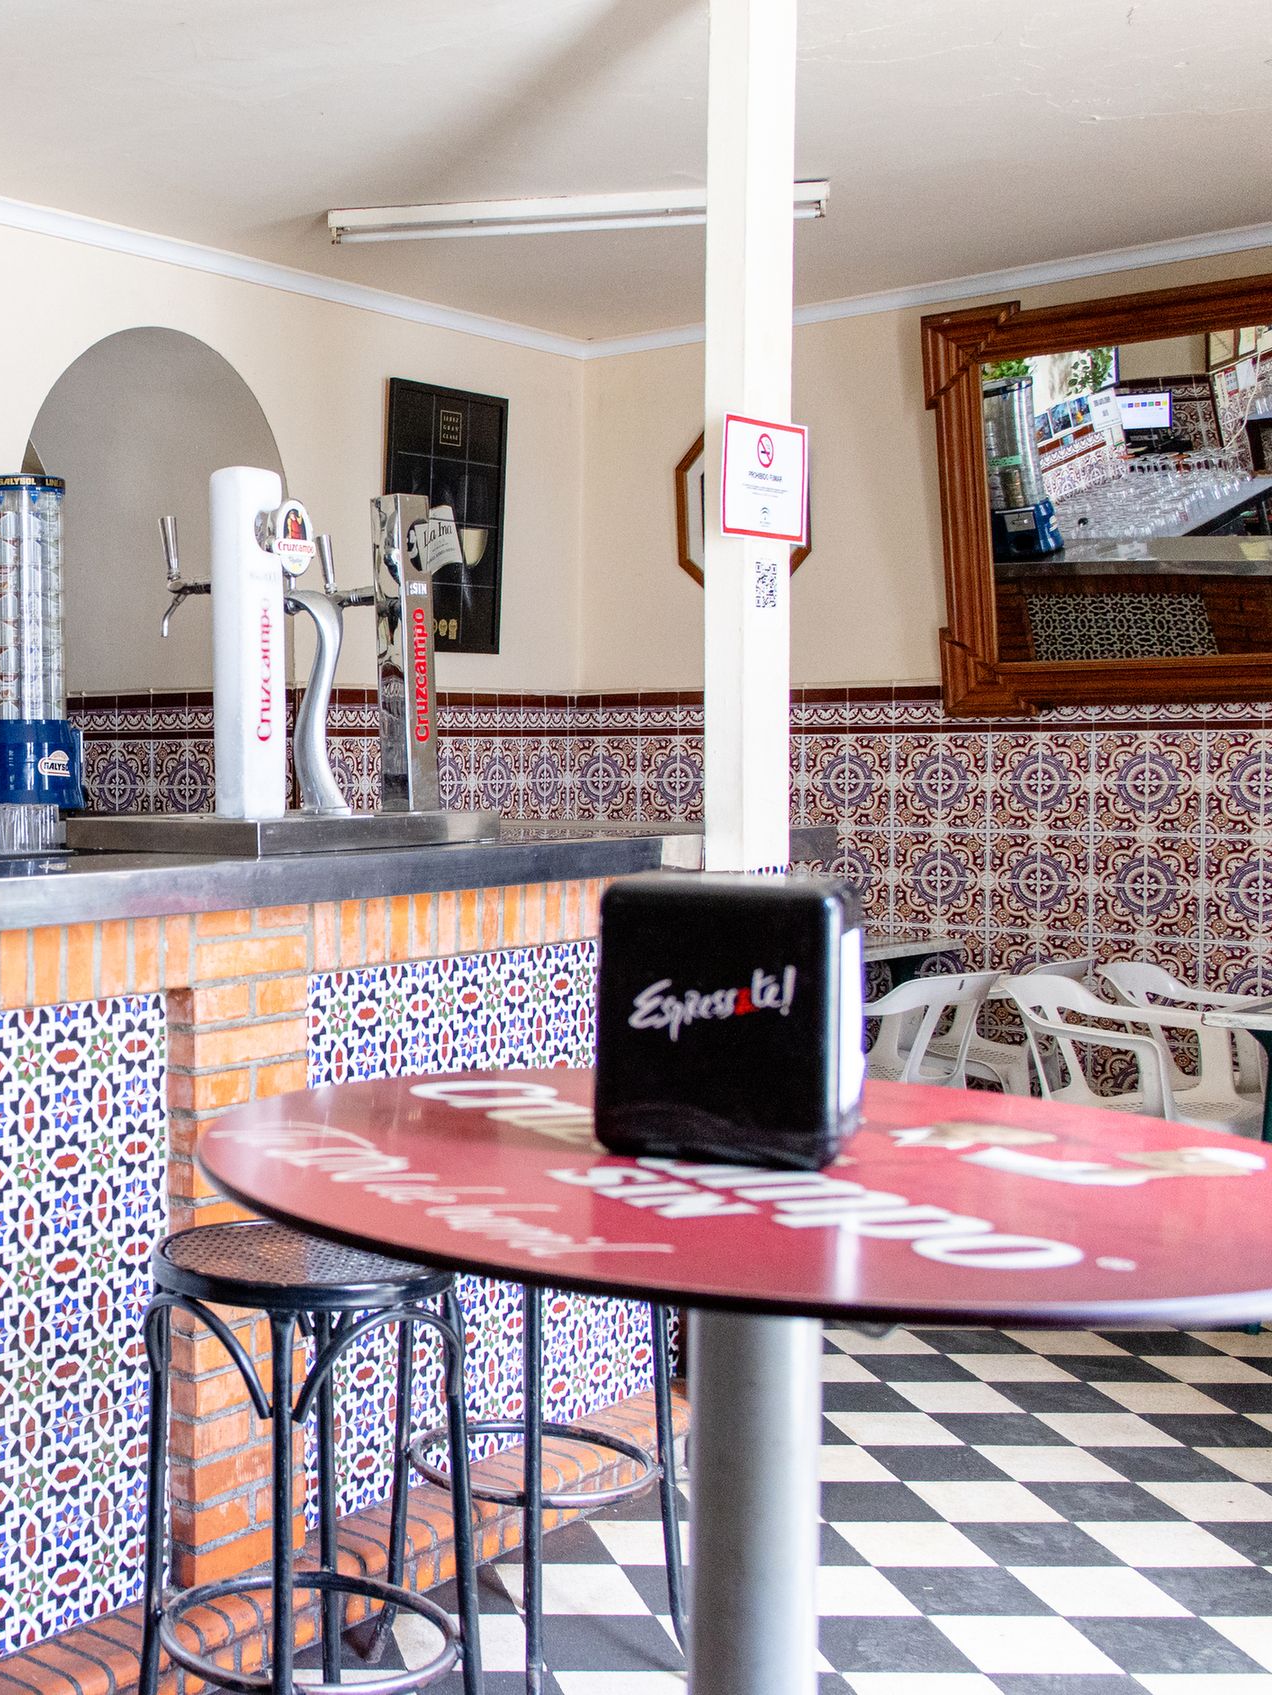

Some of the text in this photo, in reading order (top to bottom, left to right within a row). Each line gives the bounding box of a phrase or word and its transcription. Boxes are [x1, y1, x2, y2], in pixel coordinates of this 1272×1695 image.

[424, 521, 452, 548] La Ina
[256, 597, 273, 742] Cruzcampo
[414, 607, 429, 743] Cruzcampo
[545, 1165, 759, 1219] SIN
